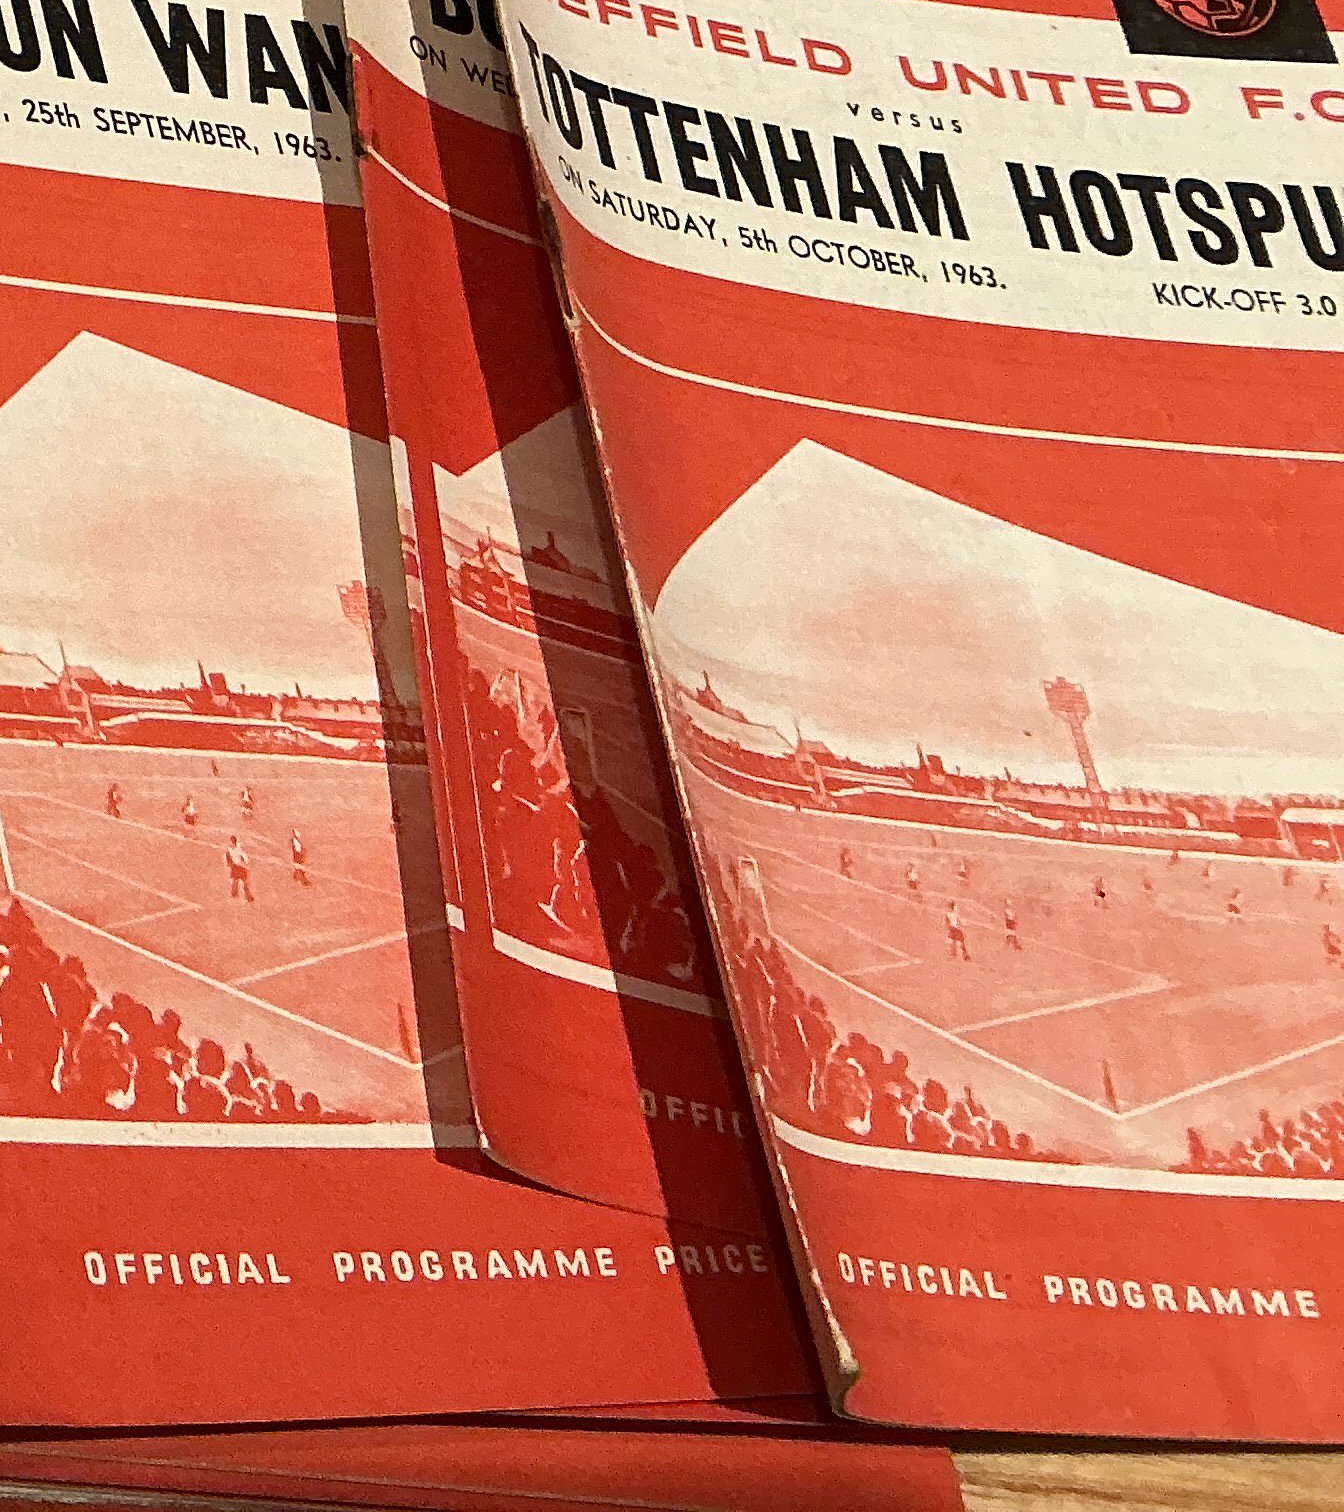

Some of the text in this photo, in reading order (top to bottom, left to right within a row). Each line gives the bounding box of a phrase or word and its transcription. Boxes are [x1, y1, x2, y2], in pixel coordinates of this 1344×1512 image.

[410, 35, 447, 73] ON
[899, 55, 1191, 114] UNITED
[22, 98, 80, 128] 25th
[94, 107, 260, 155] SEPTEMBER,
[274, 132, 342, 162] 1963.
[519, 21, 970, 240] TOTTENHAM
[846, 102, 962, 134] versus
[558, 155, 1337, 317] ON SATURDAY, 5th OCTOBER, 1963. KICK-OFF 3.0
[83, 1244, 769, 1285] OFFICIAL PROGRAMME PRICE
[838, 1252, 1320, 1318] OFFICIAL PROGRAMME
